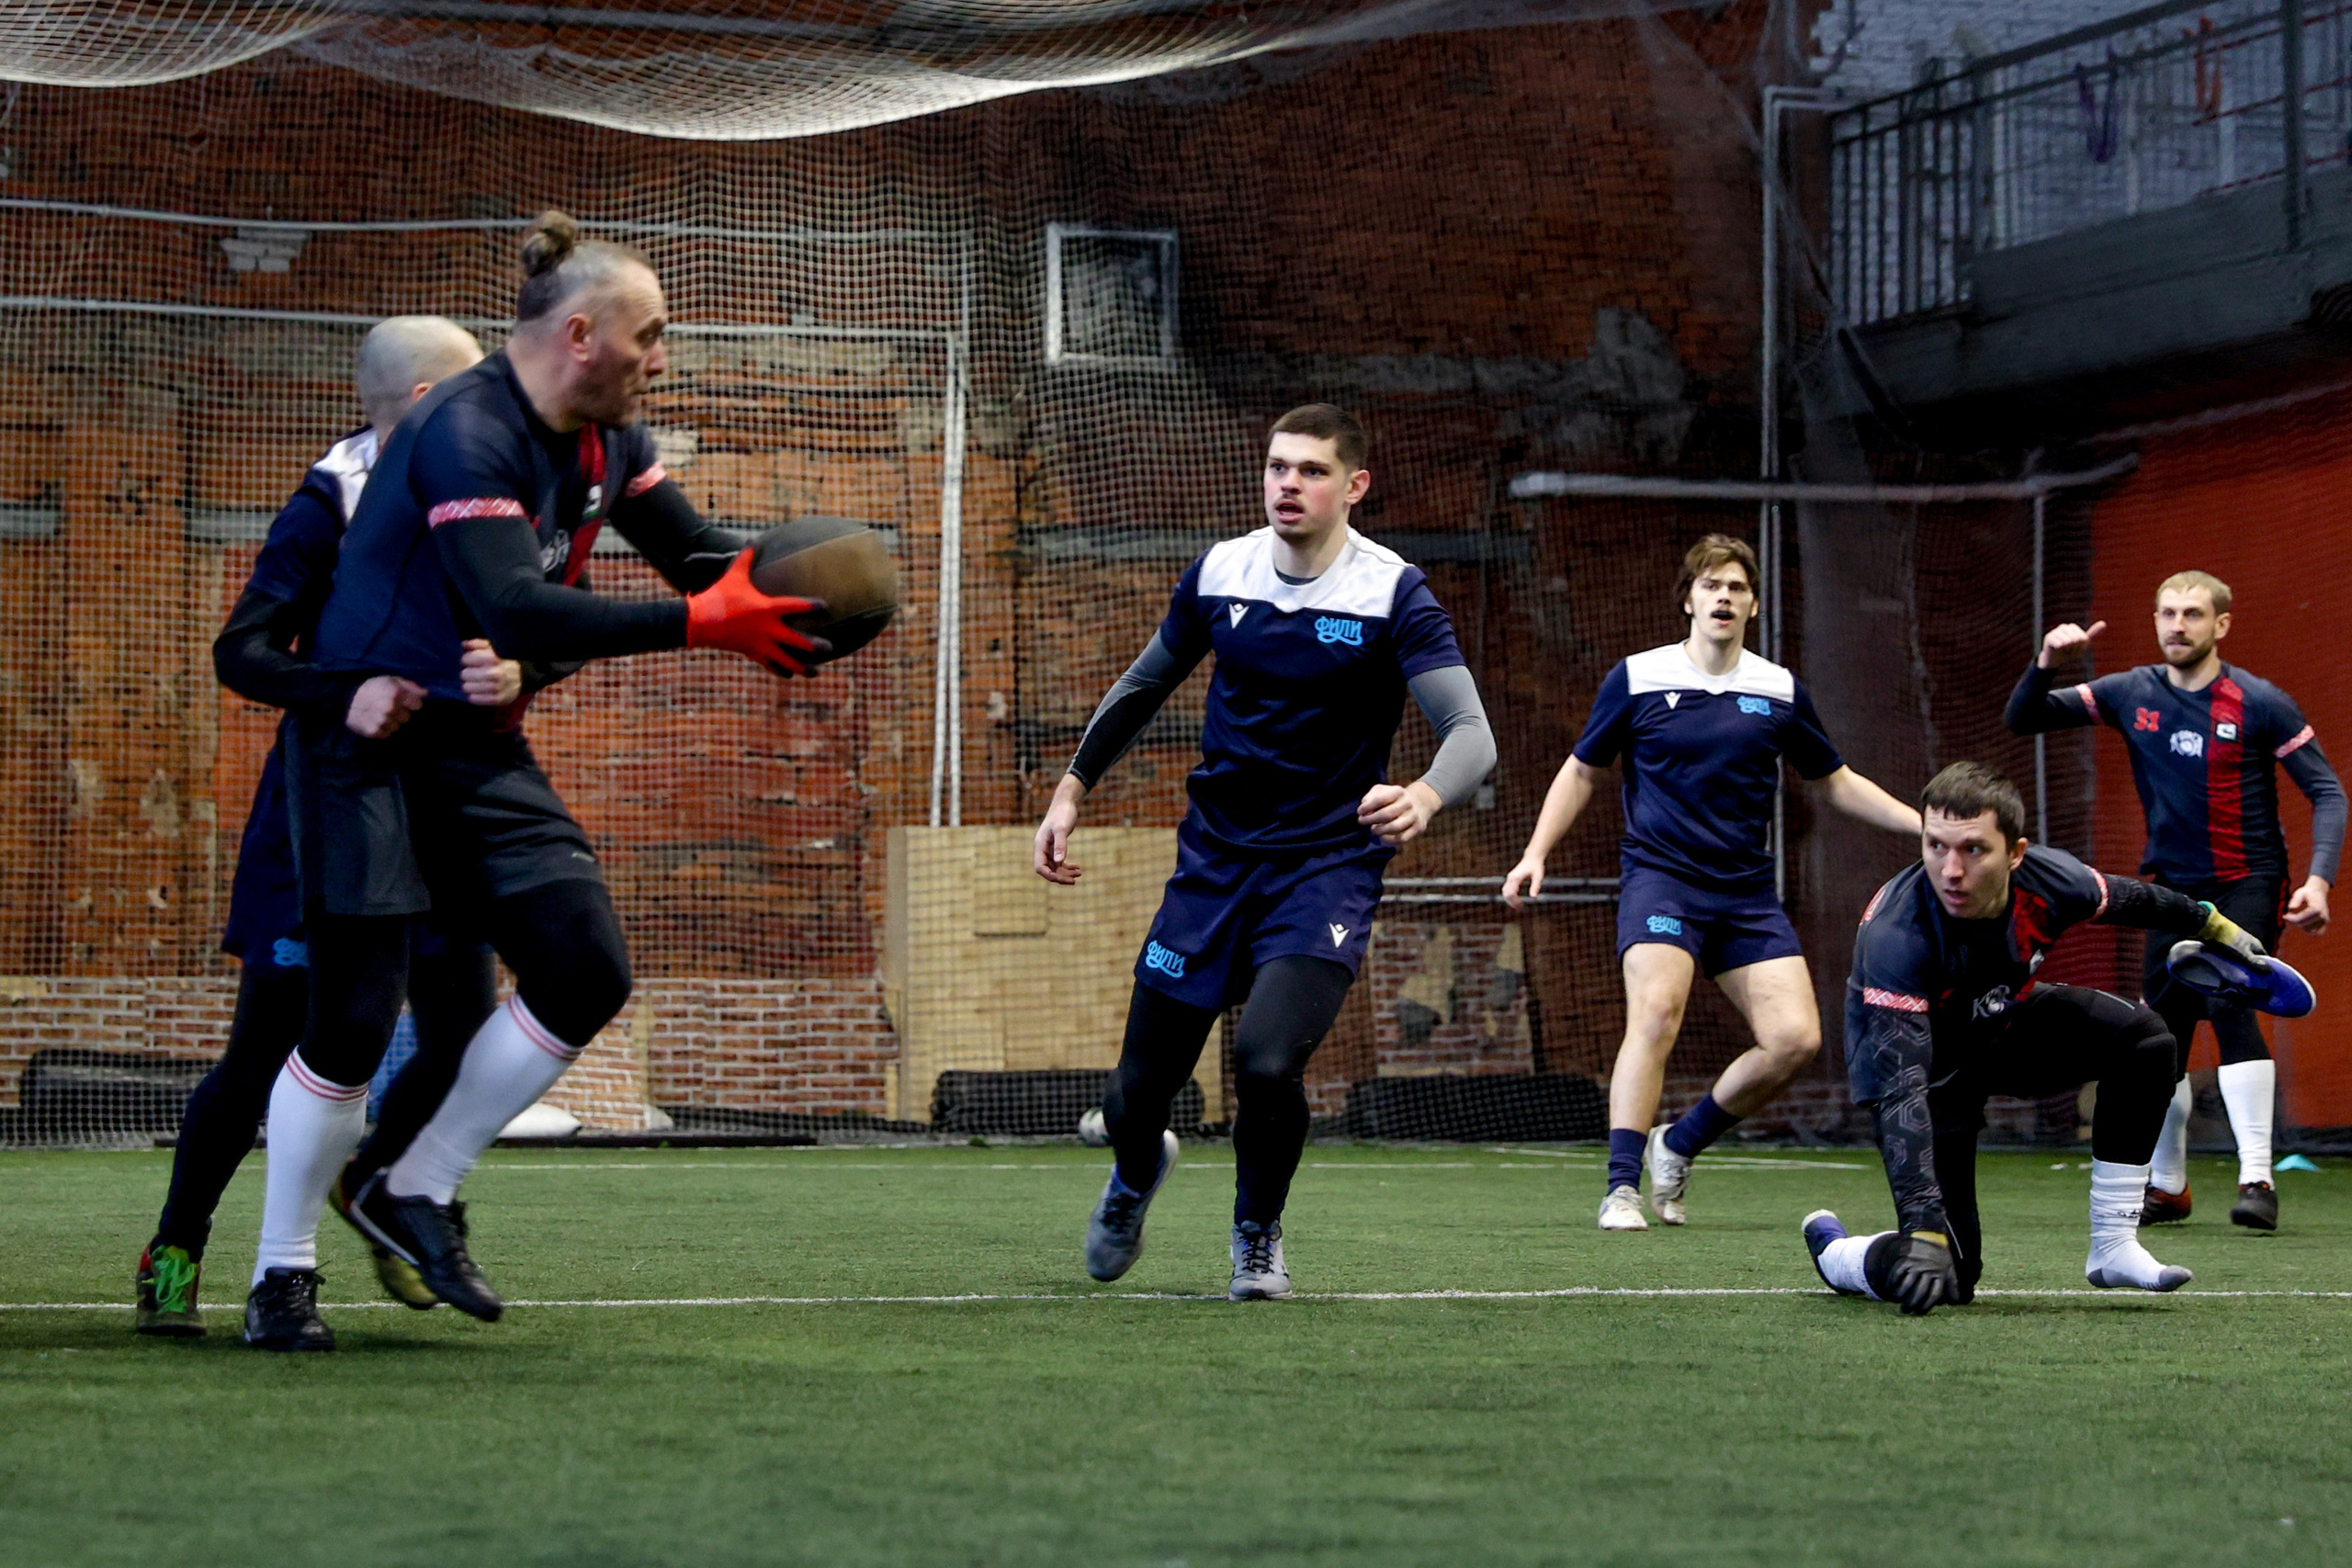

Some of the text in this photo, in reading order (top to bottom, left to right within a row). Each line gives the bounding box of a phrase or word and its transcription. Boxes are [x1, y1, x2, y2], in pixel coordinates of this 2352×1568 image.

[1315, 615, 1363, 646] ФИЛИ
[2133, 707, 2160, 732] 31
[1146, 940, 1186, 978] ФИЛИ
